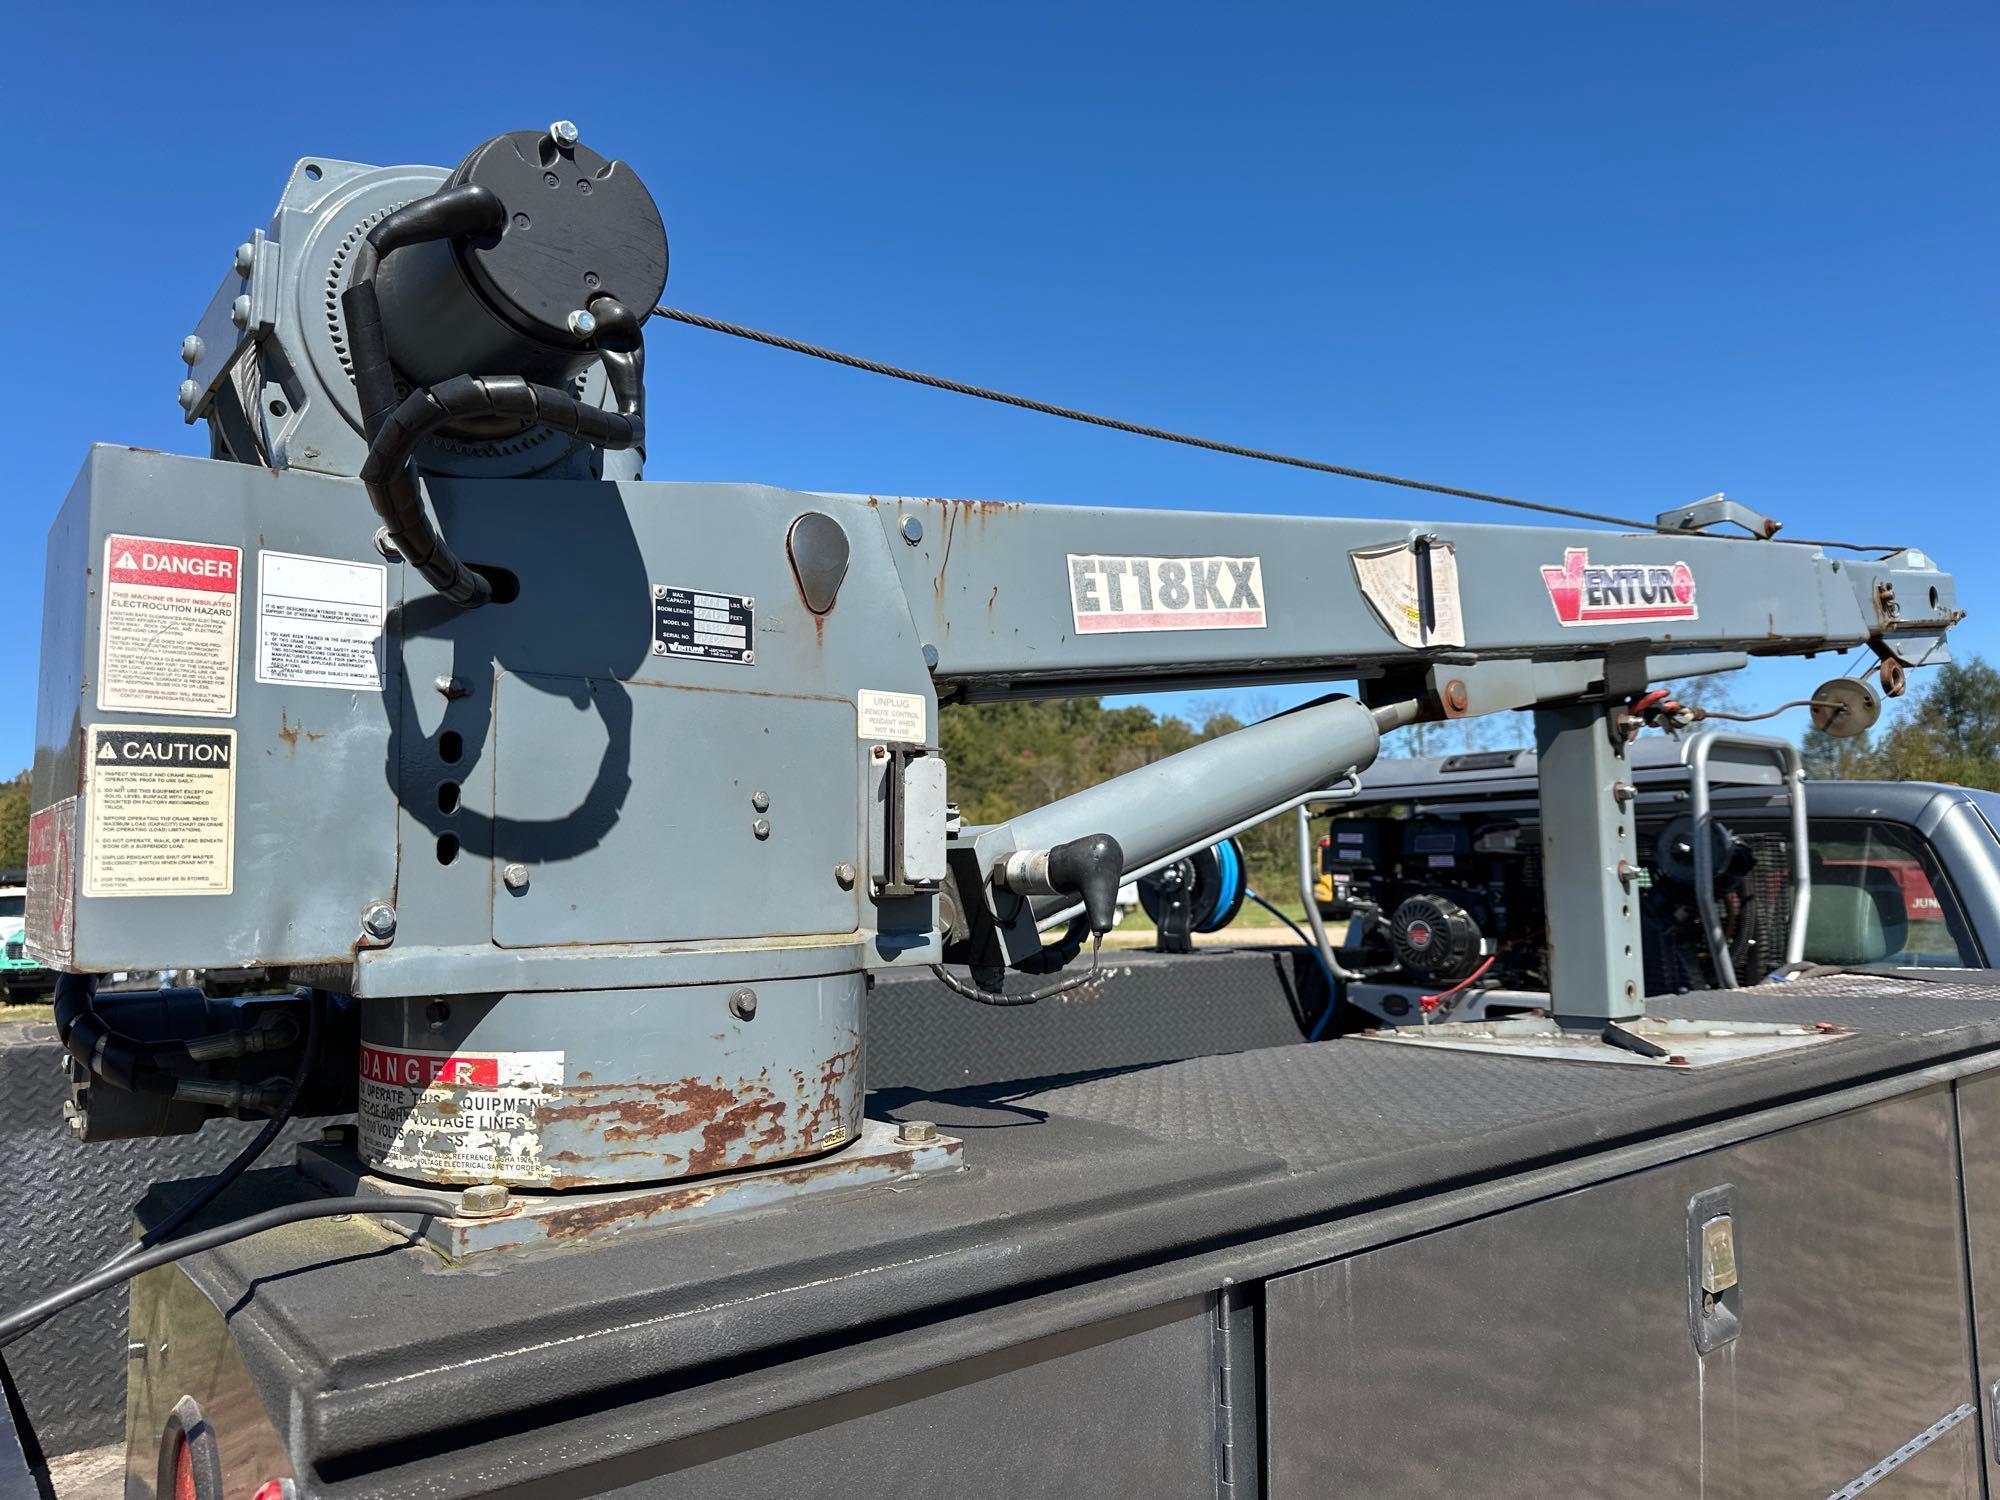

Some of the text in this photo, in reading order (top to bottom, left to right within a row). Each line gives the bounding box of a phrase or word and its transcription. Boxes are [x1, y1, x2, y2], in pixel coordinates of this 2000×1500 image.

[142, 554, 232, 578] DANGER
[1072, 560, 1260, 612] ET18KX
[1542, 551, 1694, 621] VENTURO
[111, 599, 231, 616] ELECTROCUTION HAZARD
[130, 593, 164, 601] MACHINE
[192, 598, 231, 607] INSULATED
[873, 696, 910, 708] UNPLUG
[864, 708, 920, 719] REMOTE CONTROL
[122, 742, 228, 762] CAUTION
[1912, 898, 1940, 908] JUN
[364, 1053, 473, 1085] DANGER
[368, 1084, 405, 1104] OPERATE
[463, 1096, 549, 1112] QUIPMEN
[377, 1122, 404, 1140] VOLTS
[480, 1116, 525, 1129] LINES
[452, 1153, 493, 1161] REFERENCE
[444, 1160, 486, 1169] ELECTRICAL
[515, 1164, 545, 1172] ORDERS
